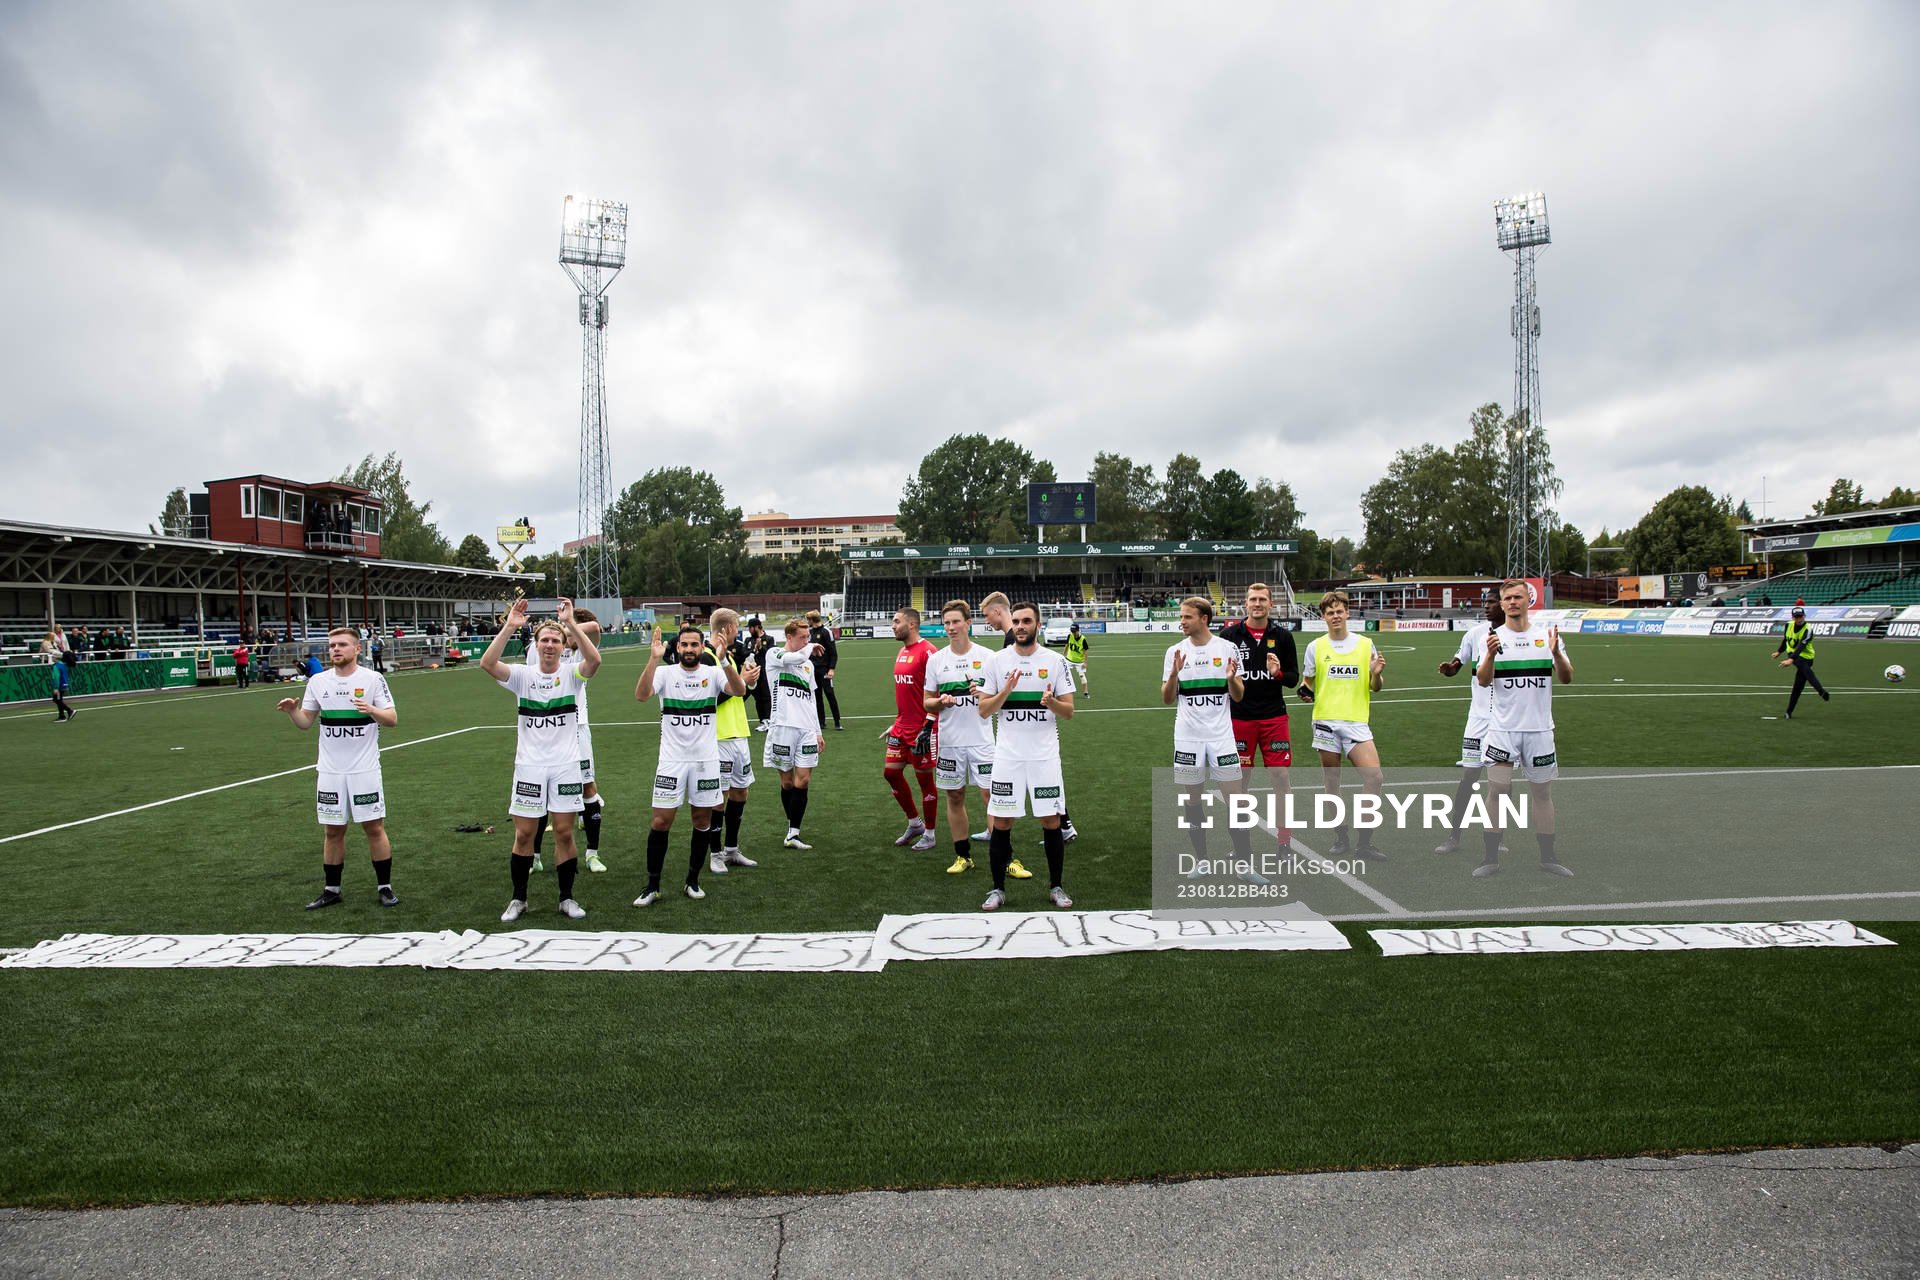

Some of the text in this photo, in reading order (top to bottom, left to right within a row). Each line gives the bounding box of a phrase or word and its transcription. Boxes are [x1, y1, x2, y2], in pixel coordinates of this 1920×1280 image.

[1041, 493, 1082, 502] 0 4
[501, 529, 525, 537] Rental
[1037, 545, 1059, 554] SSAB
[841, 628, 854, 636] XXL
[1603, 623, 1620, 632] OBOS
[1644, 624, 1663, 633] OBOS
[1712, 622, 1738, 633] SELECT
[1738, 622, 1774, 634] UNIBET
[1887, 623, 1920, 637] UNIB
[1329, 666, 1359, 675] SKAB
[894, 674, 914, 685] UNI
[1503, 678, 1547, 689] JUNI
[1187, 695, 1223, 707] JUNI
[671, 714, 711, 727] JUNI
[1006, 710, 1048, 722] JUNI
[526, 715, 567, 729] JUNI
[325, 727, 366, 738] JUNI
[518, 782, 539, 791] VIRTUAL
[890, 912, 1161, 955] GAIS
[1389, 930, 1542, 952] WAY
[1562, 926, 1691, 947] OUT
